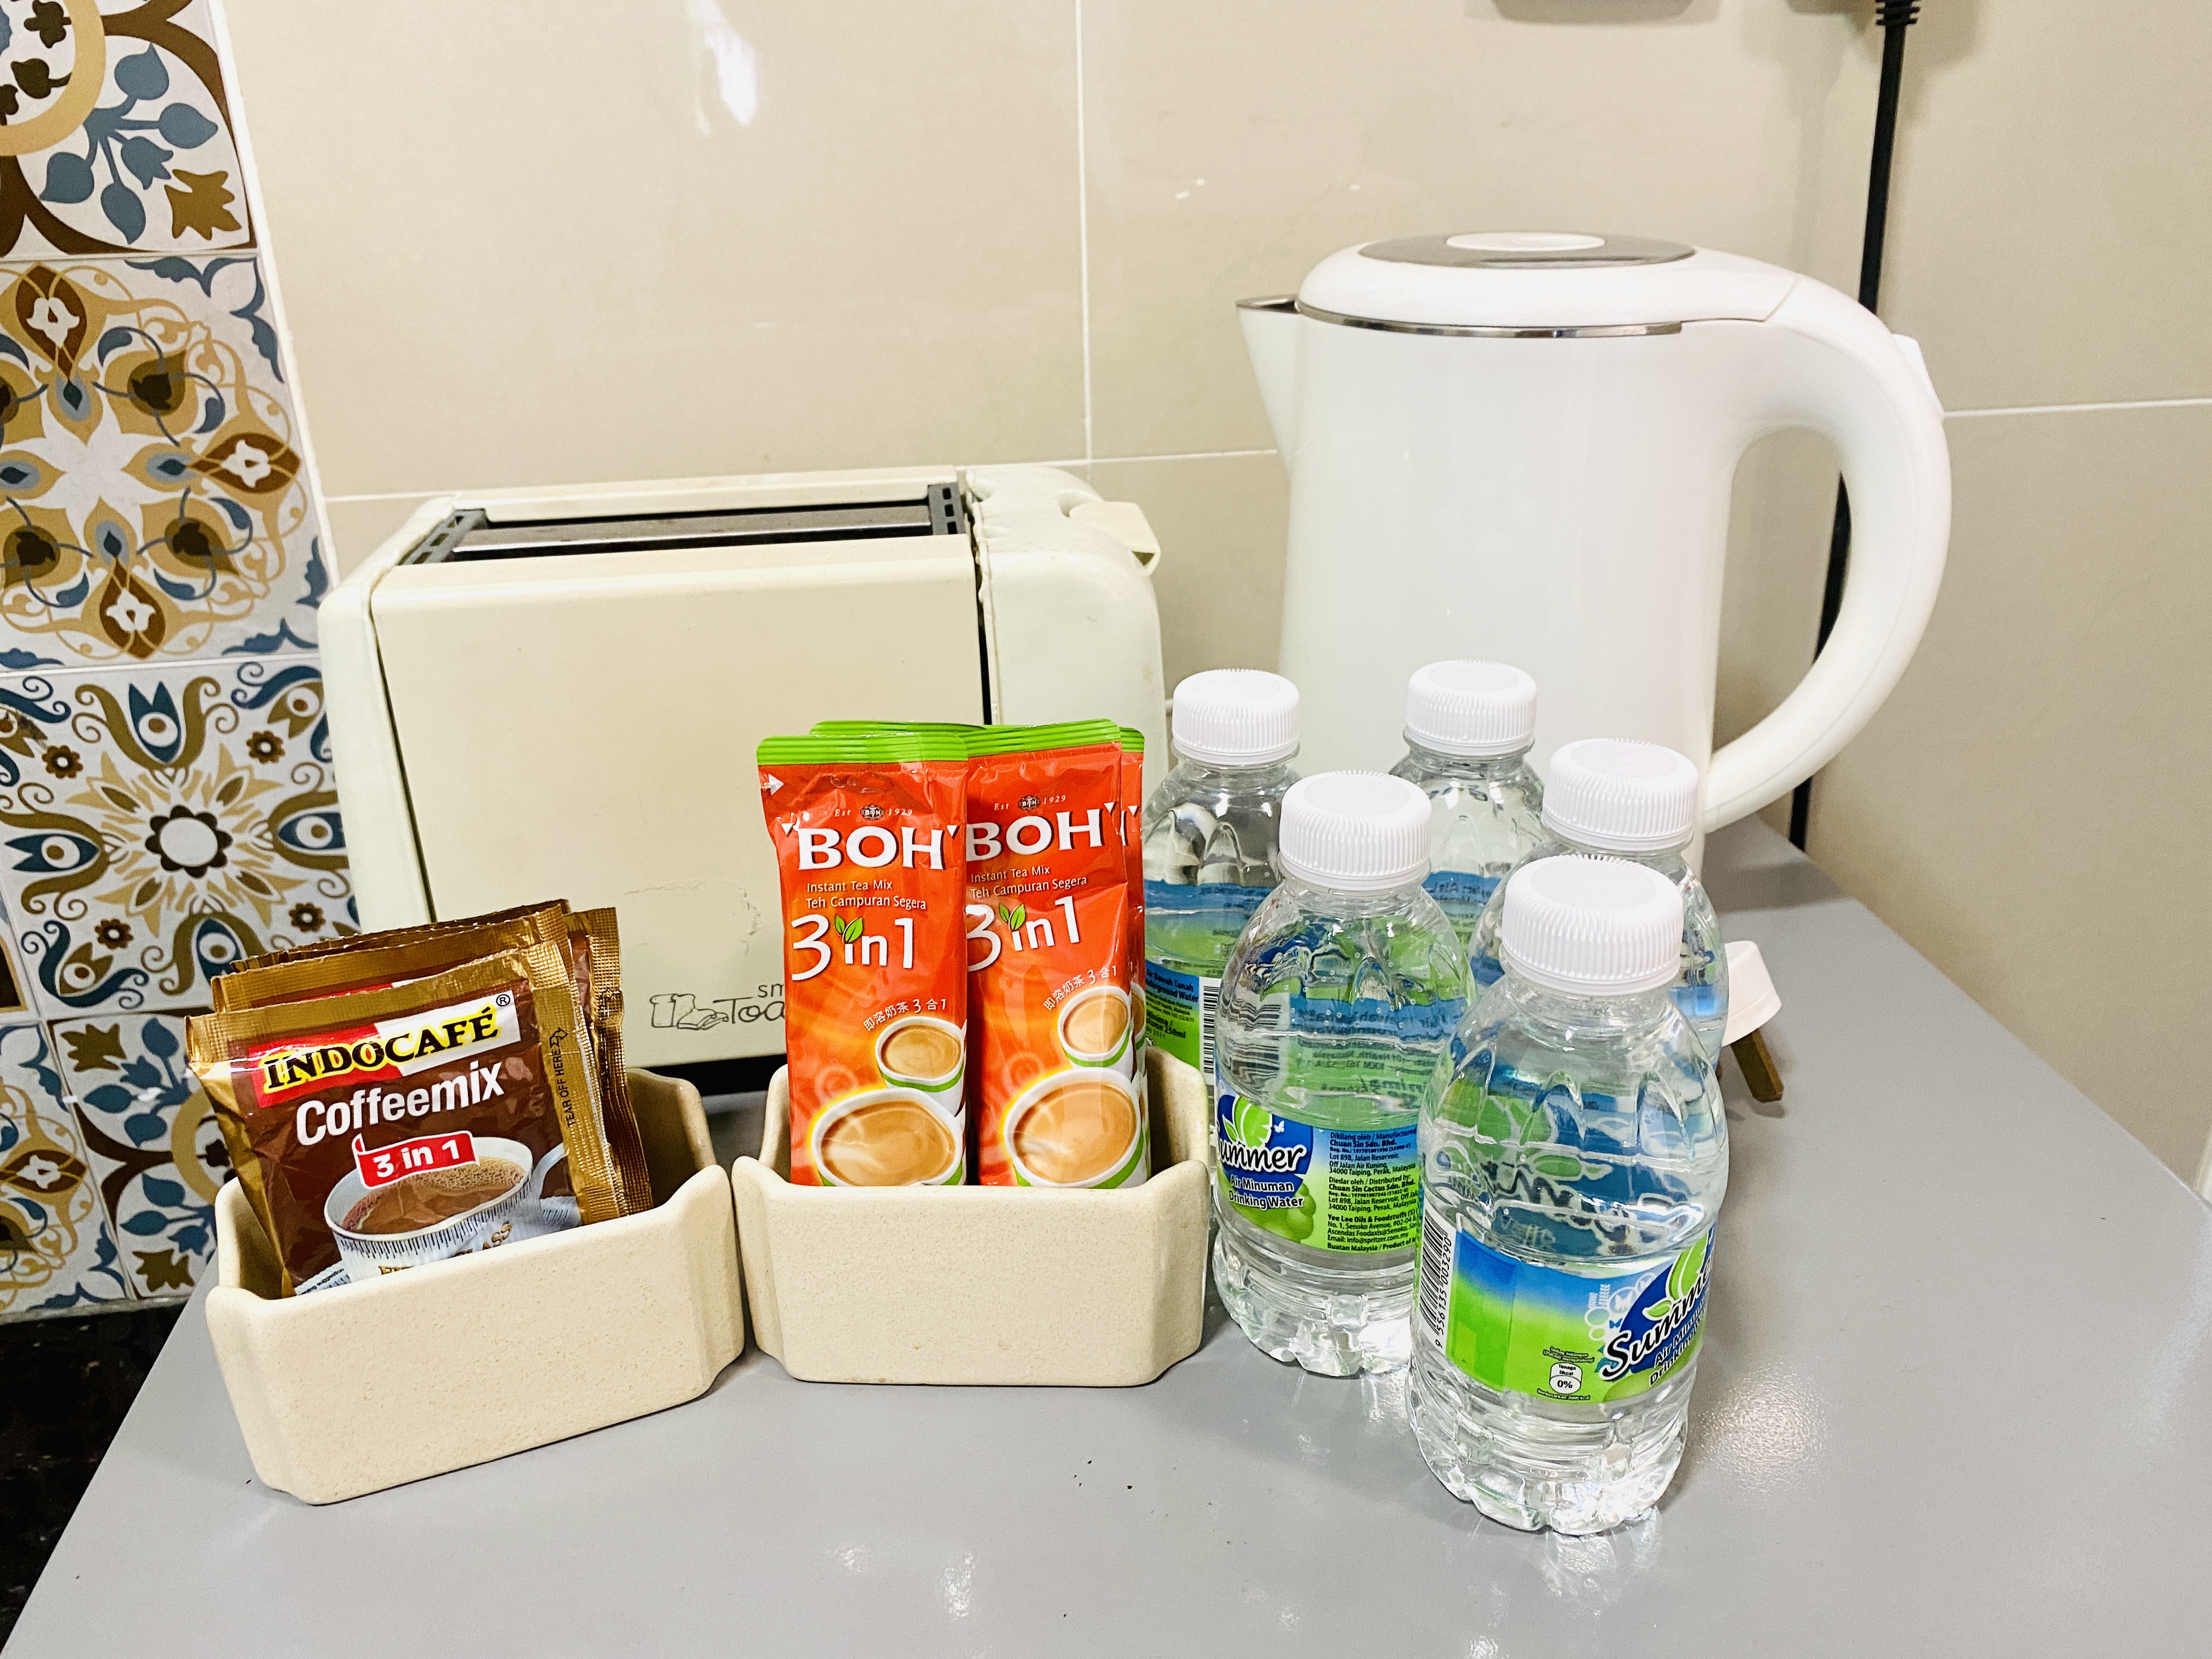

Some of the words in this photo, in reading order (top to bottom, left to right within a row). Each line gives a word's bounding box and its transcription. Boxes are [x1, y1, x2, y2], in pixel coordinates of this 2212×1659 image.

[1043, 795, 1066, 804] 1929
[971, 870, 1007, 883] Instant
[1011, 868, 1028, 878] Tea
[1031, 865, 1050, 876] Mix
[807, 882, 846, 893] Instant
[850, 881, 868, 890] Tea
[873, 879, 892, 889] Mix
[971, 888, 990, 899] Teh
[994, 881, 1049, 896] Campuran
[1052, 876, 1087, 890] Segera
[806, 898, 826, 909] Teh
[830, 895, 890, 908] Campuran
[894, 895, 926, 910] Segera
[1174, 980, 1194, 992] Tanah
[1178, 991, 1199, 1003] Water
[1165, 1025, 1186, 1039] 250ml
[263, 1007, 500, 1090] INDOCAFÉ
[551, 1046, 565, 1076] HERE
[556, 1076, 569, 1098] OFF
[296, 1060, 506, 1147] Coffeemix
[562, 1099, 576, 1127] TEAR
[1330, 1132, 1356, 1141] Dikilang
[1376, 1127, 1417, 1139] Manufactured
[373, 1156, 394, 1178] 3
[402, 1146, 433, 1170] in
[442, 1139, 460, 1161] 1
[1219, 1140, 1305, 1171] ummer
[1340, 1154, 1353, 1162] 898,
[1349, 1169, 1372, 1177] Taiping,
[1392, 1163, 1416, 1172] Malaysia
[1366, 1162, 1388, 1170] Kuning,
[1230, 1175, 1241, 1187] Air
[1243, 1178, 1294, 1191] Minuman
[1329, 1176, 1349, 1185] Diedar
[1369, 1175, 1402, 1184] Distributed
[1402, 1179, 1415, 1188] Bhd.
[1229, 1189, 1267, 1209] Drinking
[1268, 1196, 1303, 1207] Water
[1372, 1195, 1399, 1204] Reservoir,
[1401, 1192, 1409, 1200] Off
[1348, 1205, 1372, 1214] Taiping,
[1393, 1199, 1417, 1209] Malaysia
[1374, 1211, 1407, 1222] Foodstuffs
[1328, 1228, 1355, 1236] Ascendas
[1328, 1234, 1346, 1243] Email:
[1327, 1243, 1350, 1251] Buatan
[1383, 1241, 1405, 1250] Product
[1440, 1237, 1452, 1285] 003290
[1436, 1287, 1447, 1335] 556135
[1435, 1339, 1443, 1348] 9
[1650, 1331, 1695, 1386] Drinking
[1655, 1345, 1672, 1366] Air
[1557, 1380, 1573, 1389] 0%
